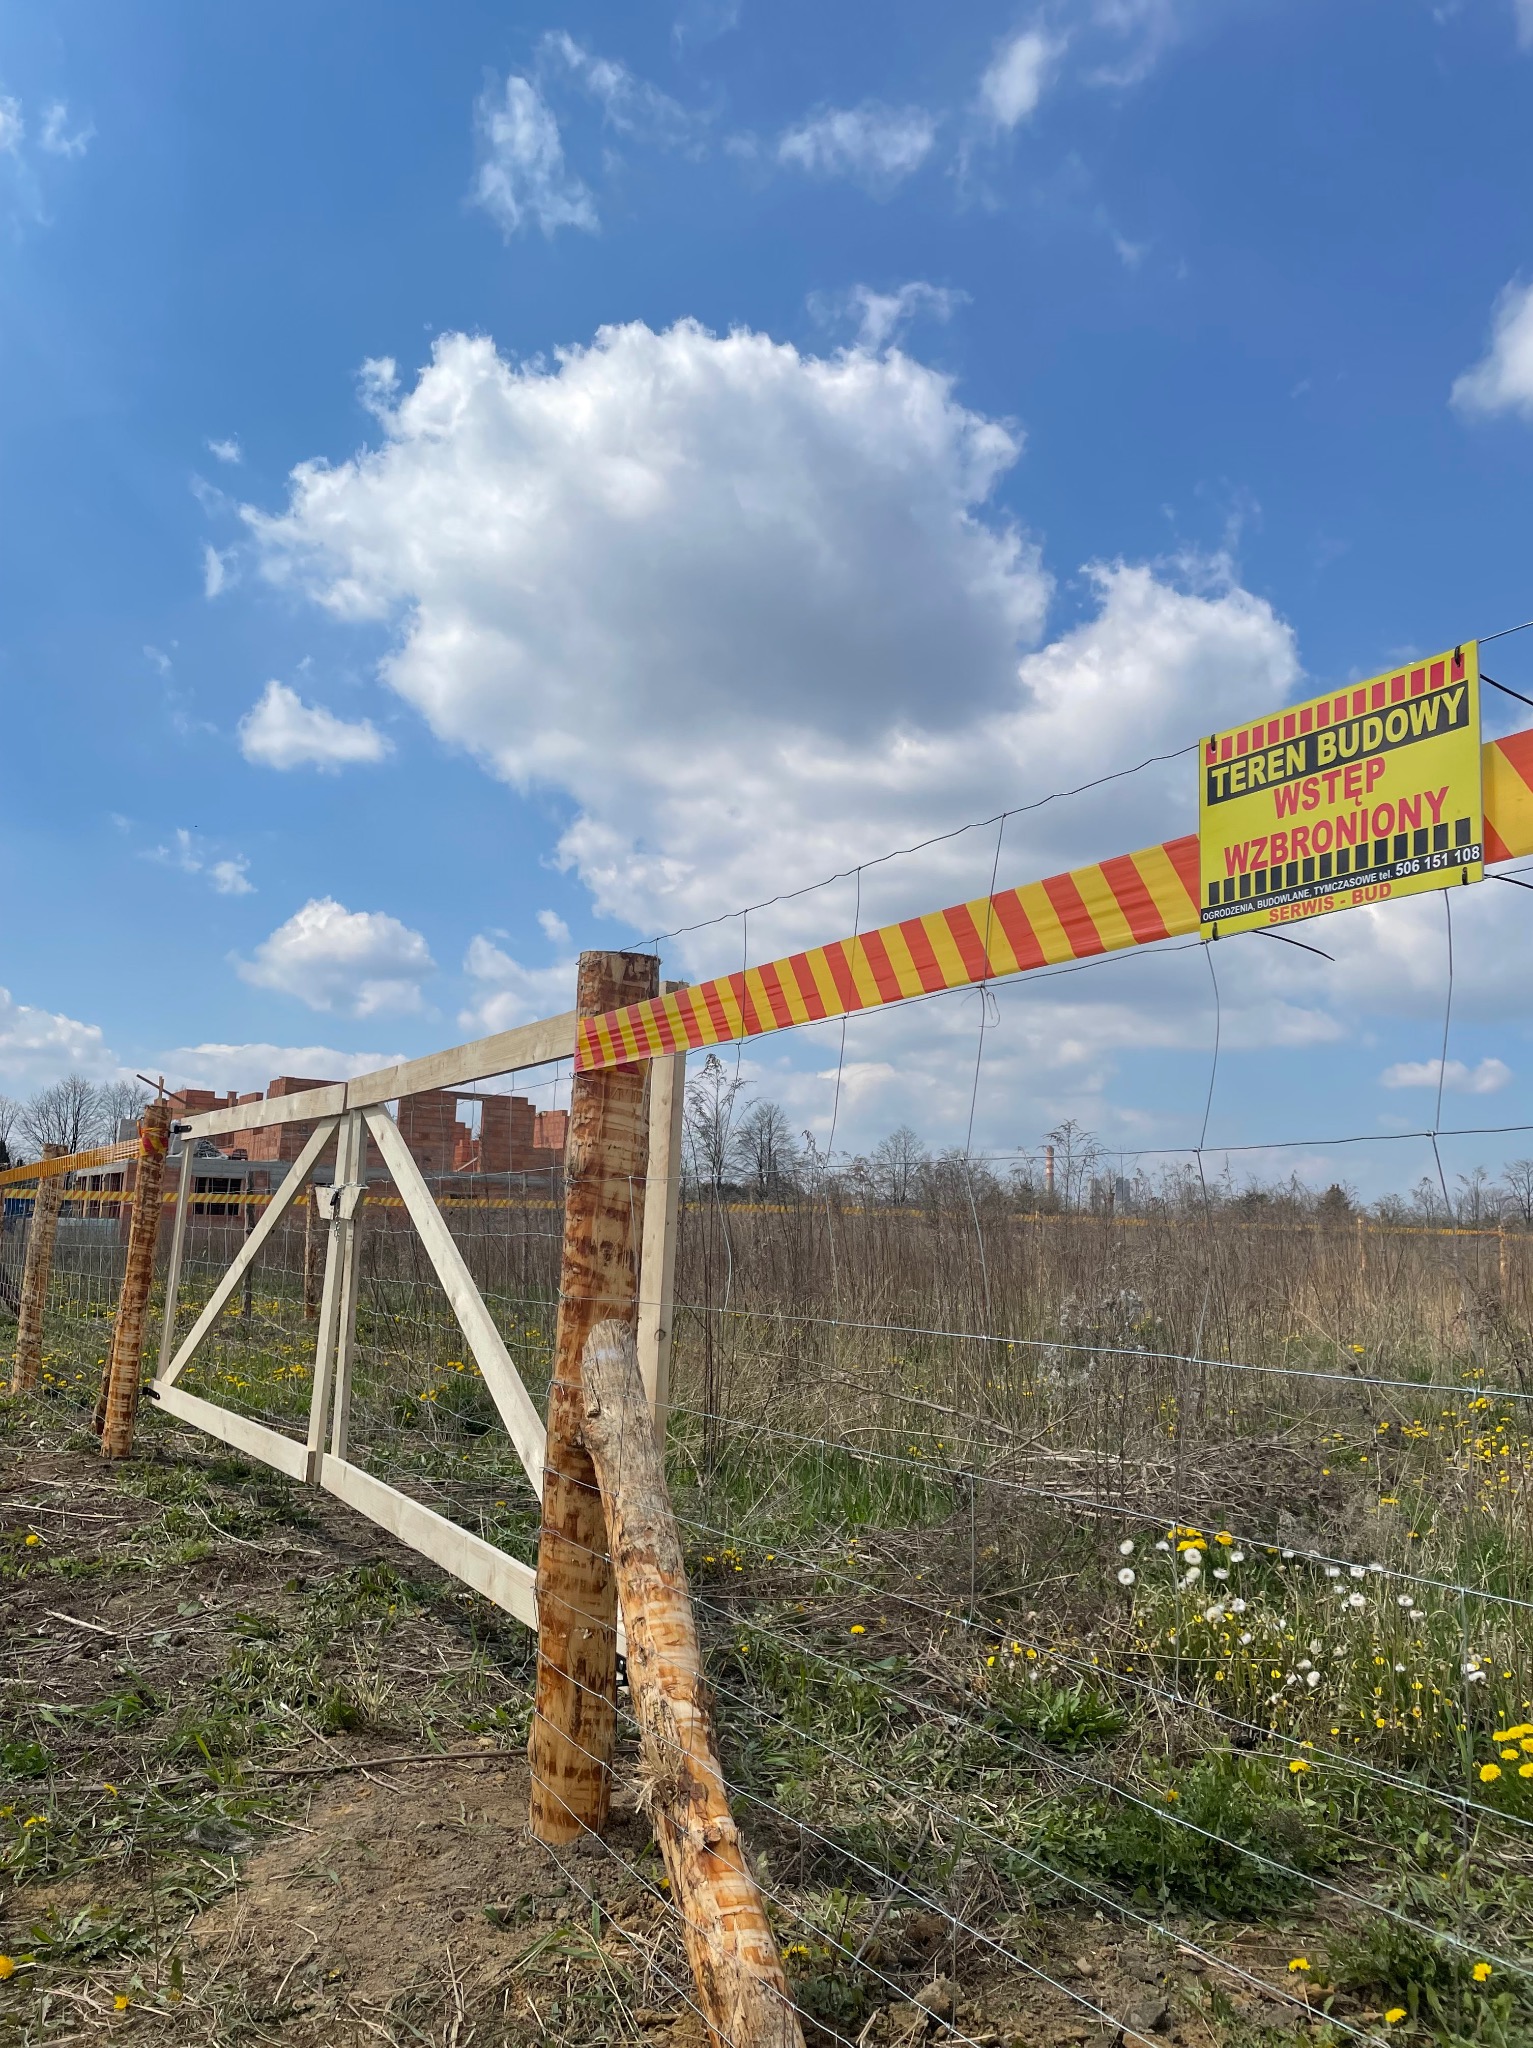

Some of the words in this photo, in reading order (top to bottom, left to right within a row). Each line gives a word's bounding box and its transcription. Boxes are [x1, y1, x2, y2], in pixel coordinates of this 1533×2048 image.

[1211, 740, 1306, 798] TEREN
[1317, 687, 1465, 767] BUDOWY
[1274, 757, 1386, 820] WSTĘP
[1224, 786, 1450, 877] WZBRONIONY
[1203, 902, 1255, 921] OGRODZENIA,
[1257, 889, 1312, 910] BUDOWLANE,
[1314, 872, 1377, 896] TYMCZASOWE
[1379, 870, 1393, 881] tel.
[1396, 859, 1420, 877] 506
[1424, 852, 1448, 870] 151
[1454, 846, 1480, 864] 108
[1269, 895, 1335, 923] SERWIS
[1352, 882, 1392, 905] BUD
